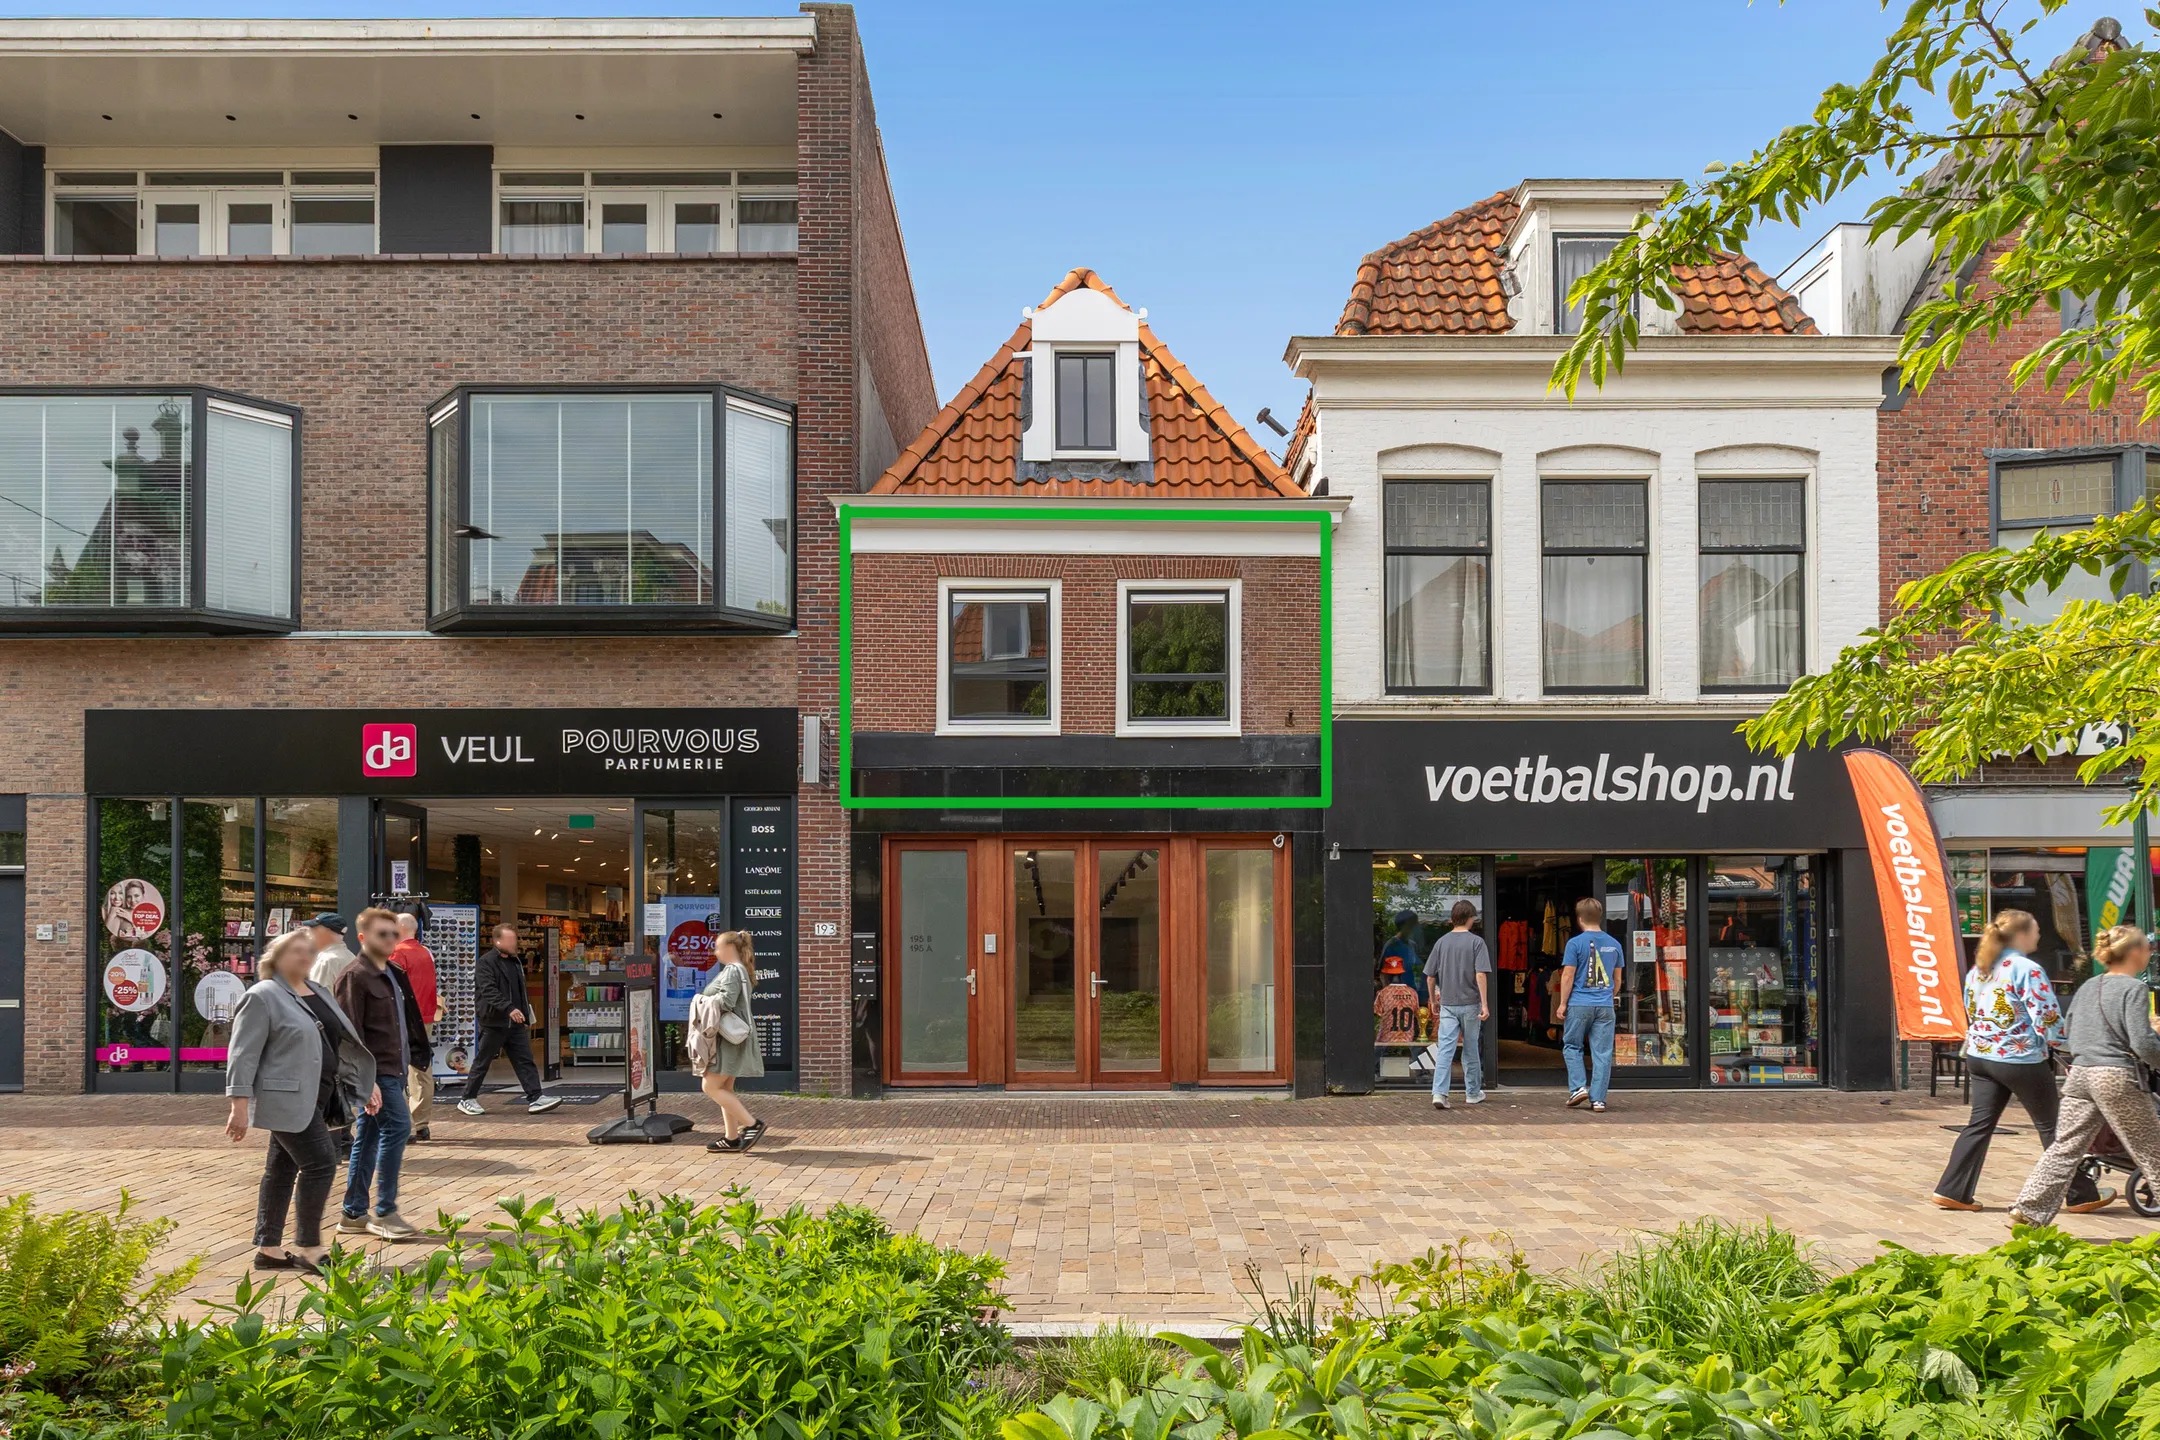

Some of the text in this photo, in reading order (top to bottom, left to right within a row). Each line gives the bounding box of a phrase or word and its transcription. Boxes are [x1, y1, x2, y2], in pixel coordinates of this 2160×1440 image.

[562, 728, 760, 754] POURVOUS
[365, 731, 411, 769] da
[440, 736, 535, 764] VEUL
[605, 758, 725, 770] PARFUMERIE
[1424, 752, 1796, 814] voetbalshop.nl
[751, 825, 775, 833] BOSS
[745, 866, 782, 874] LANCÔME
[745, 908, 782, 918] CLINIQUE
[1880, 803, 1953, 1027] voetbalshop.nl
[816, 924, 836, 935] 193
[671, 935, 717, 950] -25%
[910, 935, 924, 943] 195
[1809, 944, 1817, 981] CUP
[626, 963, 652, 979] WELKOM
[114, 986, 137, 995] -25%
[1391, 1006, 1414, 1032] 10
[109, 1046, 128, 1063] da
